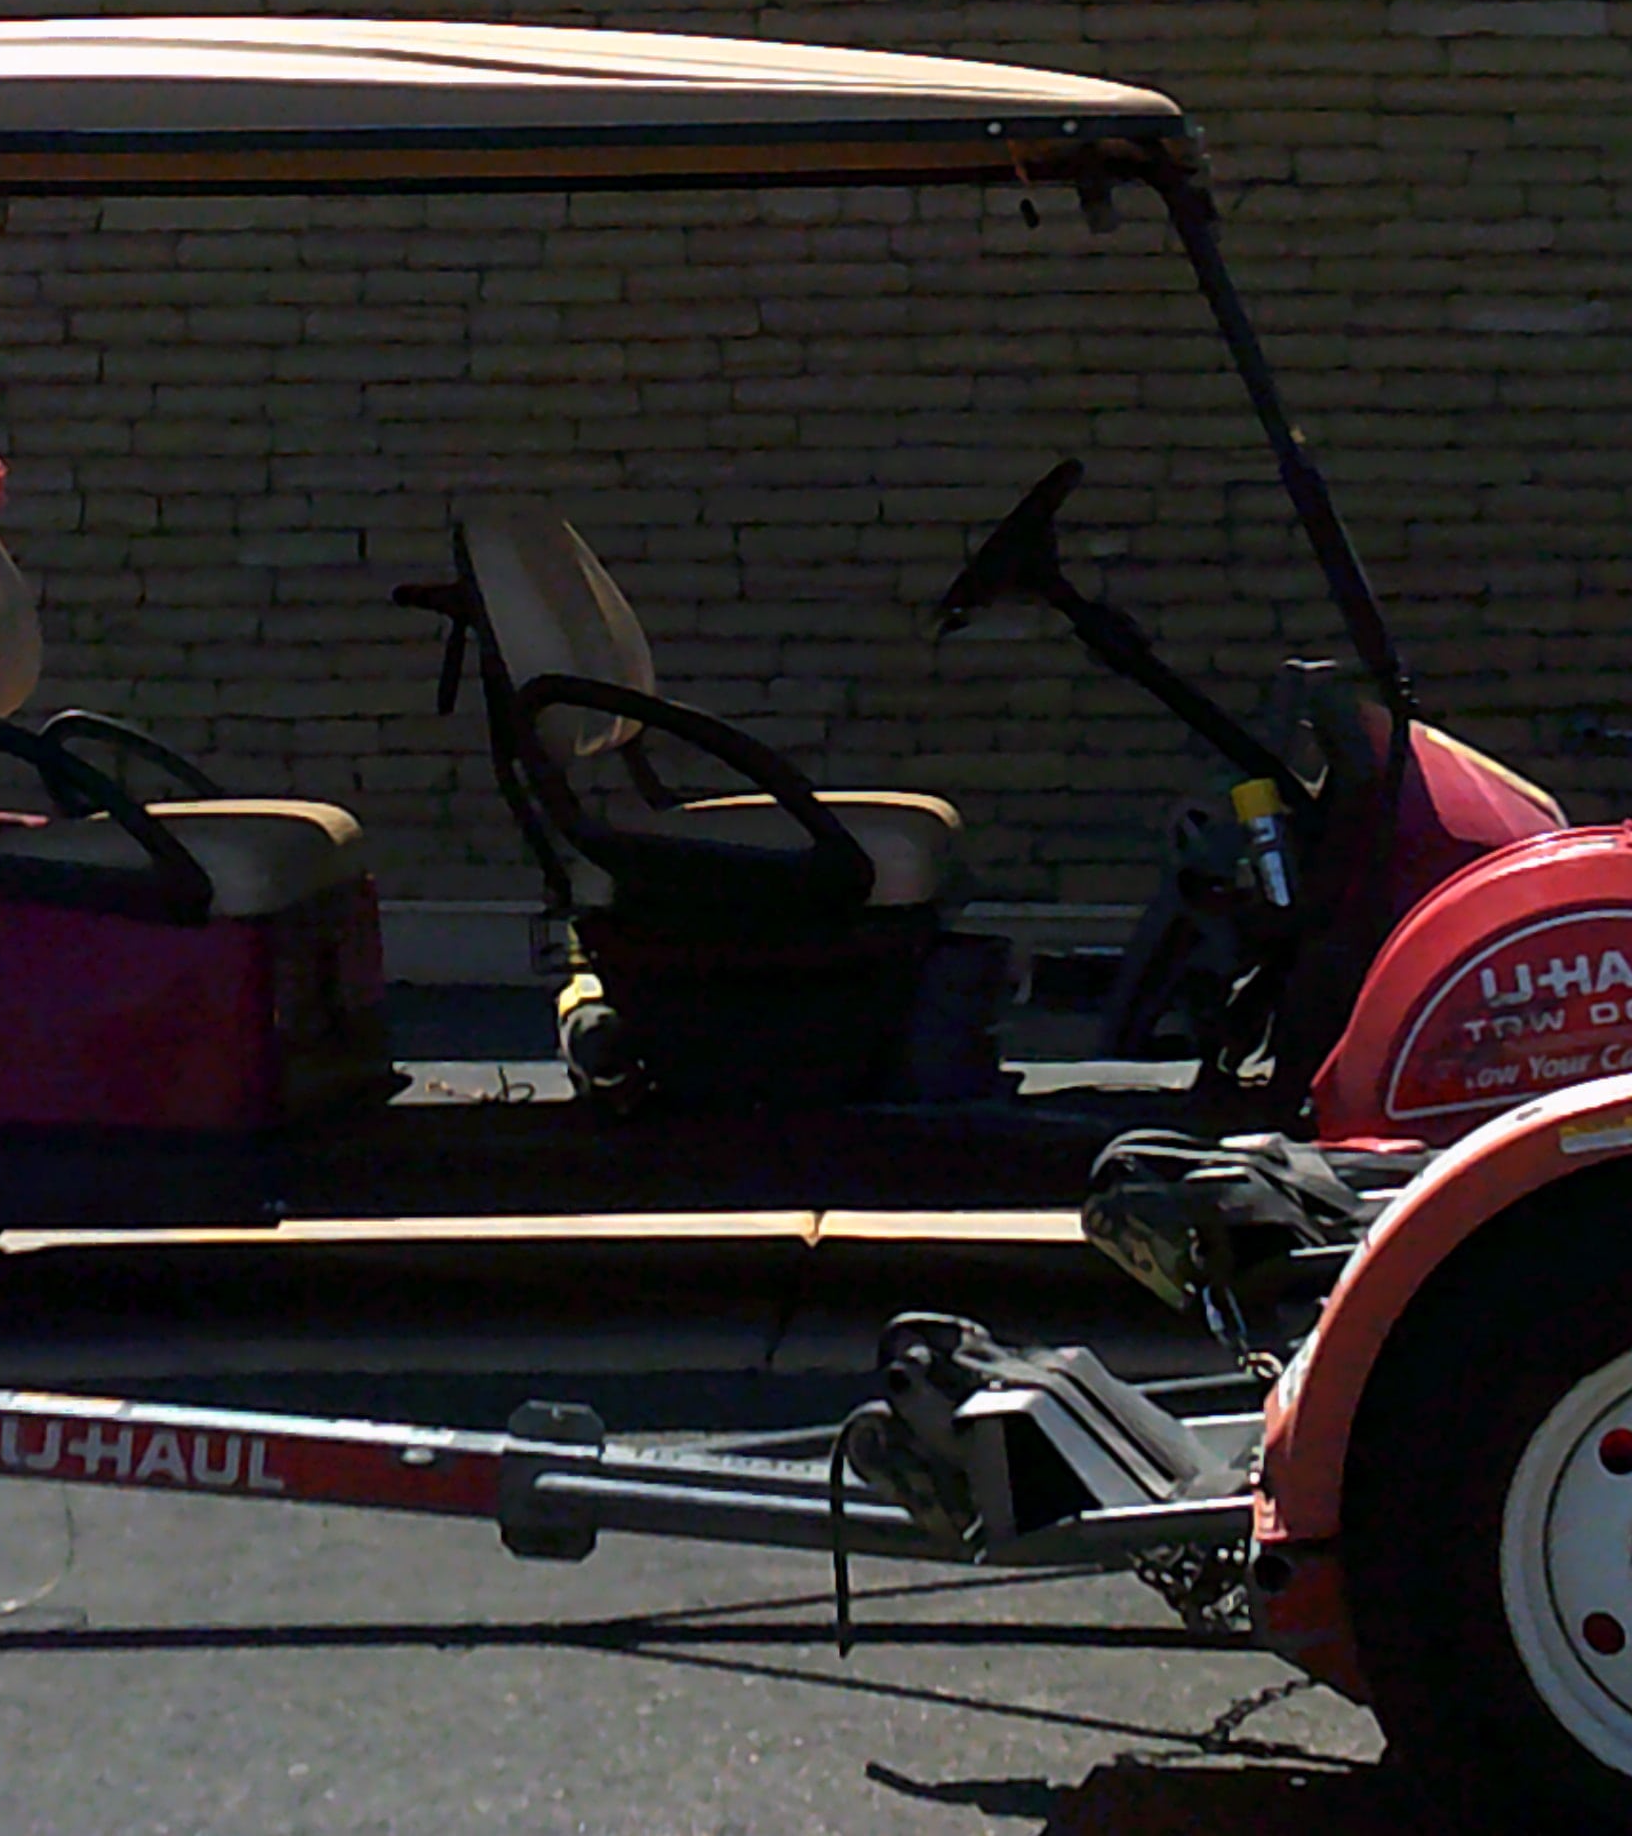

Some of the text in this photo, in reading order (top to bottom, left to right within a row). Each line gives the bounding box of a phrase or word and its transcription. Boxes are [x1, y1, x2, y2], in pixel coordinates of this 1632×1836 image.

[1463, 1009, 1566, 1043] TOW
[1528, 1052, 1592, 1081] Your
[0, 1414, 286, 1492] U-HAUL
